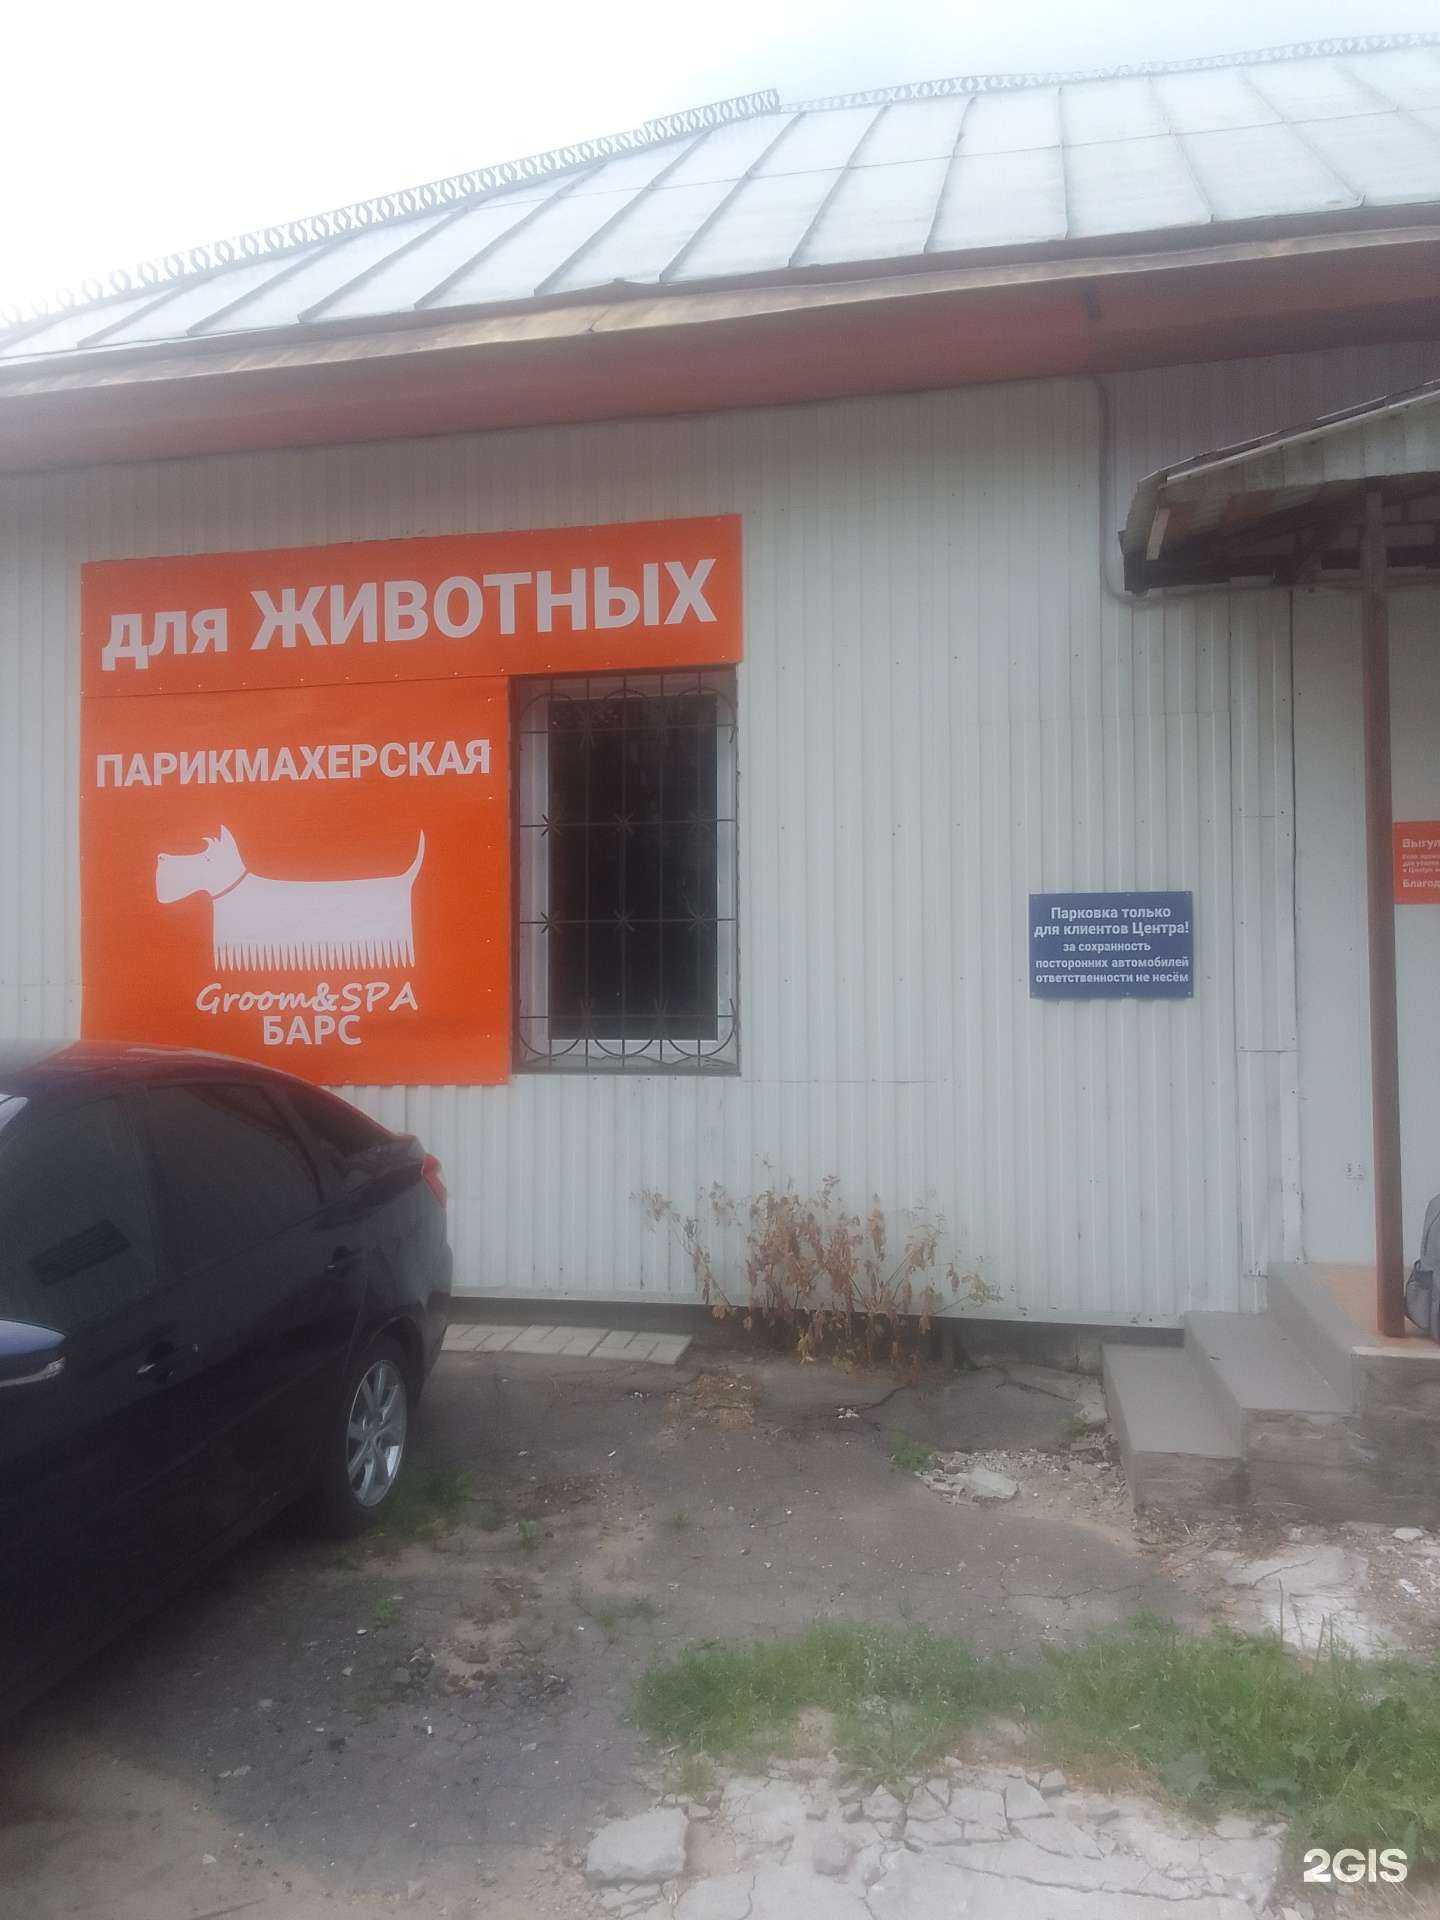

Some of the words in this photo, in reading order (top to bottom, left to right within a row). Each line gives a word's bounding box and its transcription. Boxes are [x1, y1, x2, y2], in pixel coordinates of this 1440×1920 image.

[101, 608, 229, 672] для
[250, 558, 717, 651] ЖИВОТНЫХ
[96, 738, 491, 788] ПАРИКМАХЕРСКАЯ
[1051, 907, 1118, 921] Парковка
[1121, 907, 1171, 919] только
[1034, 924, 1060, 938] для
[1063, 924, 1129, 935] клиентов
[1132, 921, 1189, 936] Центра!
[1063, 943, 1075, 951] за
[1078, 941, 1151, 953] сохранность
[1036, 960, 1108, 970] посторонних
[1111, 956, 1189, 967] автомобилей
[1036, 973, 1133, 983] ответственности
[1136, 973, 1150, 982] не
[1152, 971, 1189, 982] несём
[195, 981, 419, 1014] Groom&SPA
[263, 1014, 362, 1046] БАРС
